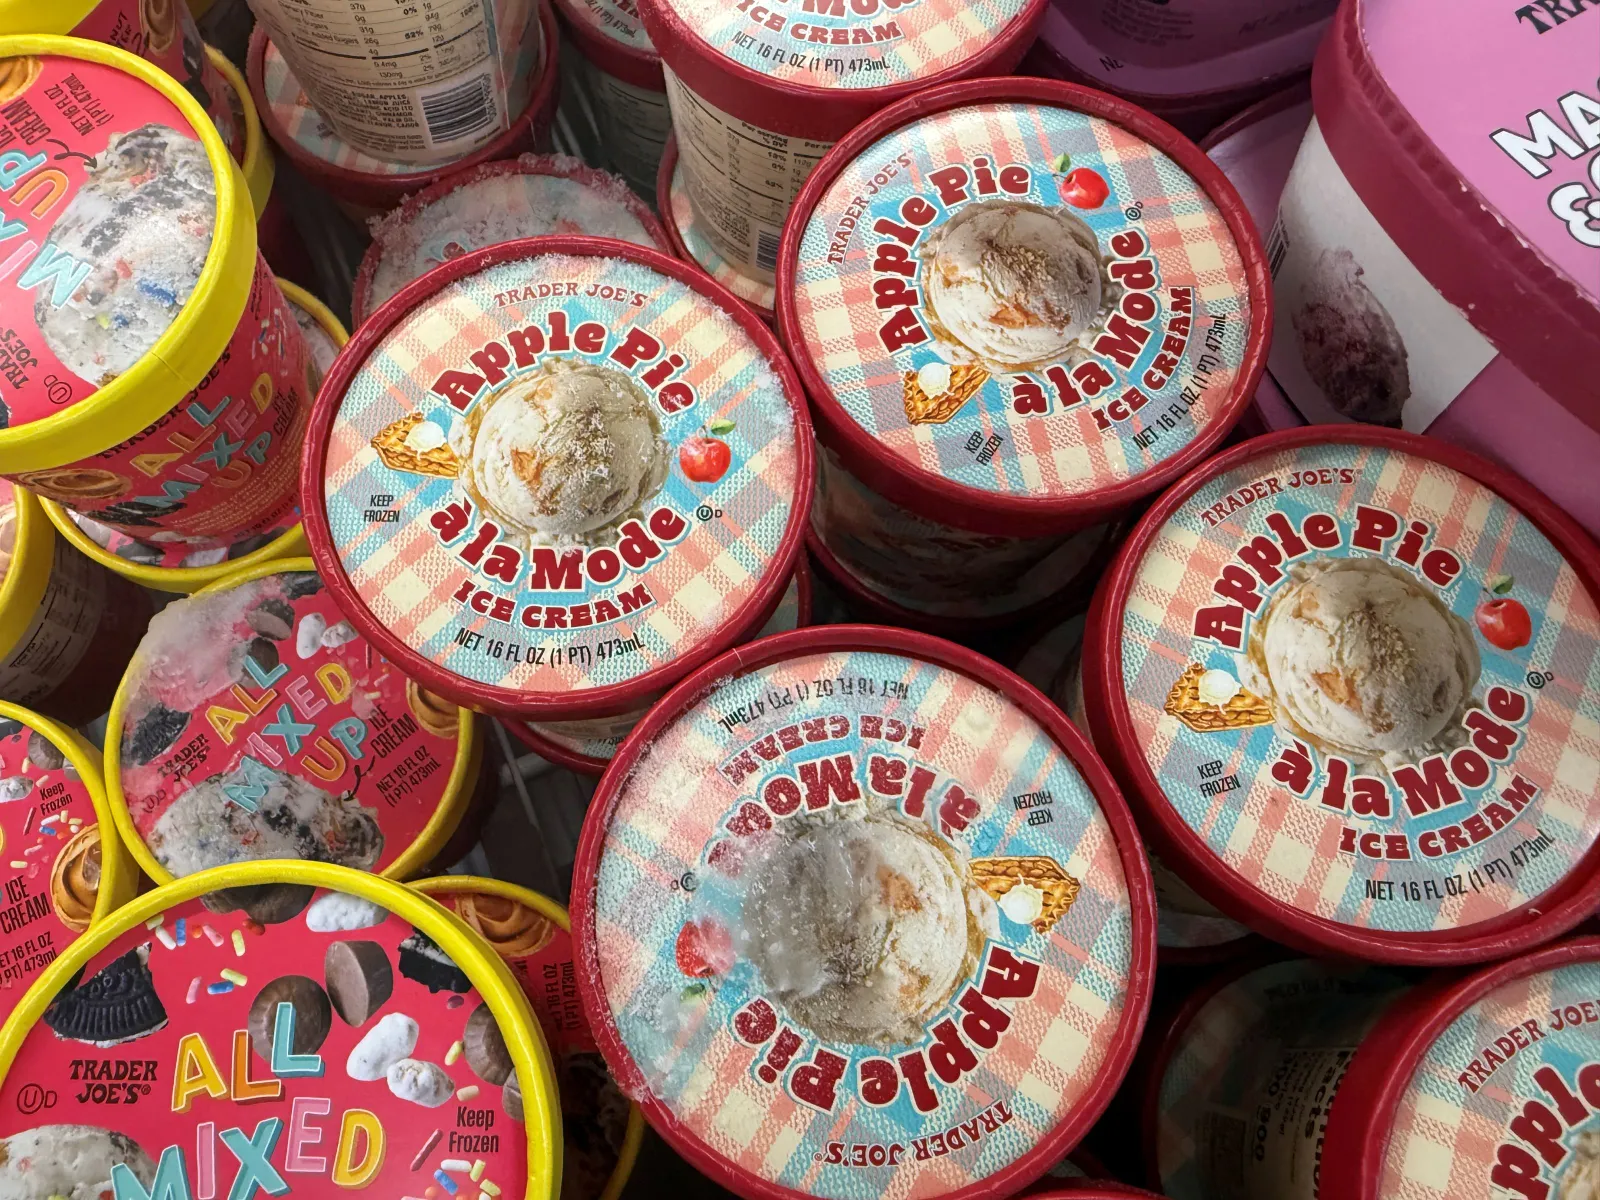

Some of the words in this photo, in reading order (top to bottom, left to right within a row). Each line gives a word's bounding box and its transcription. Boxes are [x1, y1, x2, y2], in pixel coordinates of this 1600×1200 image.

[790, 20, 902, 45] CREAM
[731, 30, 755, 52] NET
[756, 38, 773, 57] 16
[772, 44, 788, 64] FL
[790, 52, 806, 68] OZ
[809, 55, 822, 72] (1
[825, 58, 844, 76] PT)
[848, 54, 891, 74] 473mL
[44, 84, 64, 100] OZ
[55, 95, 72, 110] FL
[82, 98, 105, 120] PT)
[0, 97, 51, 146] CREAM
[62, 105, 80, 120] 16
[70, 116, 95, 136] NET
[96, 114, 114, 127] (1
[827, 196, 870, 264] TRADER
[866, 152, 913, 194] JOE'S
[872, 196, 937, 354] Apple
[928, 157, 1030, 206] Pie
[494, 282, 579, 308] TRADER
[586, 284, 648, 308] JOE'S
[1013, 376, 1048, 415] à
[1046, 361, 1114, 408] la
[1094, 230, 1156, 370] Mode
[1205, 314, 1226, 352] 473mL
[0, 326, 38, 369] JOE'S
[430, 312, 606, 412] Apple
[609, 326, 694, 414] Pie
[1092, 386, 1150, 431] ICE
[1143, 287, 1192, 391] CREAM
[1193, 372, 1207, 392] (1
[1196, 353, 1220, 379] PT)
[1168, 401, 1188, 423] FL
[1180, 386, 1198, 407] OZ
[130, 396, 232, 478] ALL
[133, 372, 274, 506] MIXED
[1133, 426, 1160, 450] NET
[1156, 412, 1174, 432] 16
[210, 431, 273, 490] UP
[964, 431, 984, 454] KEEP
[976, 433, 1004, 466] FROZEN
[370, 494, 394, 506] KEEP
[1200, 477, 1284, 528] TRADER
[1288, 468, 1354, 488] JOE'S
[364, 510, 400, 523] FROZEN
[430, 499, 473, 542] à
[459, 522, 521, 582] la
[531, 508, 686, 590] Mode
[1194, 512, 1340, 649] Apple
[1352, 505, 1461, 586] Pie
[454, 580, 516, 623] ICE
[522, 583, 654, 629] CREAM
[454, 628, 484, 652] NET
[486, 638, 504, 658] 16
[506, 644, 521, 662] FL
[526, 647, 546, 665] OZ
[550, 648, 562, 668] (1
[569, 646, 592, 666] PT)
[596, 632, 646, 660] 473mL
[205, 655, 288, 745] ALL
[768, 689, 794, 710] PT)
[797, 680, 810, 700] (1
[812, 679, 834, 696] OZ
[836, 677, 854, 694] FL
[858, 678, 875, 695] 16
[881, 680, 909, 700] NET
[369, 704, 394, 732] ICE
[718, 700, 765, 734] 473mL
[860, 714, 926, 750] ICE
[222, 662, 352, 814] MIXED
[301, 716, 366, 782] UP
[370, 713, 419, 758] CREAM
[721, 715, 850, 786] CREAM
[1271, 739, 1313, 794] à
[1322, 758, 1390, 818] la
[1392, 686, 1526, 816] Mode
[158, 733, 210, 778] TRADER
[376, 776, 397, 794] NET
[405, 755, 419, 771] FL
[414, 745, 430, 762] OZ
[1197, 760, 1224, 780] KEEP
[40, 782, 65, 802] Keep
[394, 781, 413, 802] PT)
[410, 756, 442, 786] 473mL
[870, 756, 937, 818] la
[1200, 774, 1241, 798] FROZEN
[40, 794, 73, 816] Frozen
[708, 754, 861, 878] Mode
[1013, 792, 1053, 811] FROZEN
[1028, 810, 1054, 826] KEEP
[1340, 828, 1411, 860] ICE
[1418, 775, 1540, 858] CREAM
[1366, 880, 1394, 900] NET
[1400, 880, 1422, 902] 16
[1424, 880, 1443, 900] FL
[1445, 875, 1469, 896] OZ
[1468, 870, 1485, 894] (1
[1484, 859, 1513, 881] PT)
[1510, 828, 1556, 868] 473mL
[5, 875, 30, 905] ICE
[0, 892, 52, 935] CREAM
[12, 944, 24, 961] 16
[24, 938, 39, 956] FL
[37, 930, 54, 951] OZ
[543, 963, 558, 979] OZ
[860, 946, 1040, 1112] Apple
[171, 1002, 322, 1112] ALL
[735, 998, 848, 1112] Pie
[1458, 1018, 1547, 1094] TRADER
[1550, 1001, 1600, 1032] JOE
[69, 1060, 158, 1082] TRADER
[456, 1106, 495, 1131] Keep
[910, 1100, 1013, 1161] TRADER
[1491, 1063, 1600, 1200] pple
[110, 1097, 384, 1200] MIXED
[448, 1131, 500, 1153] Frozen
